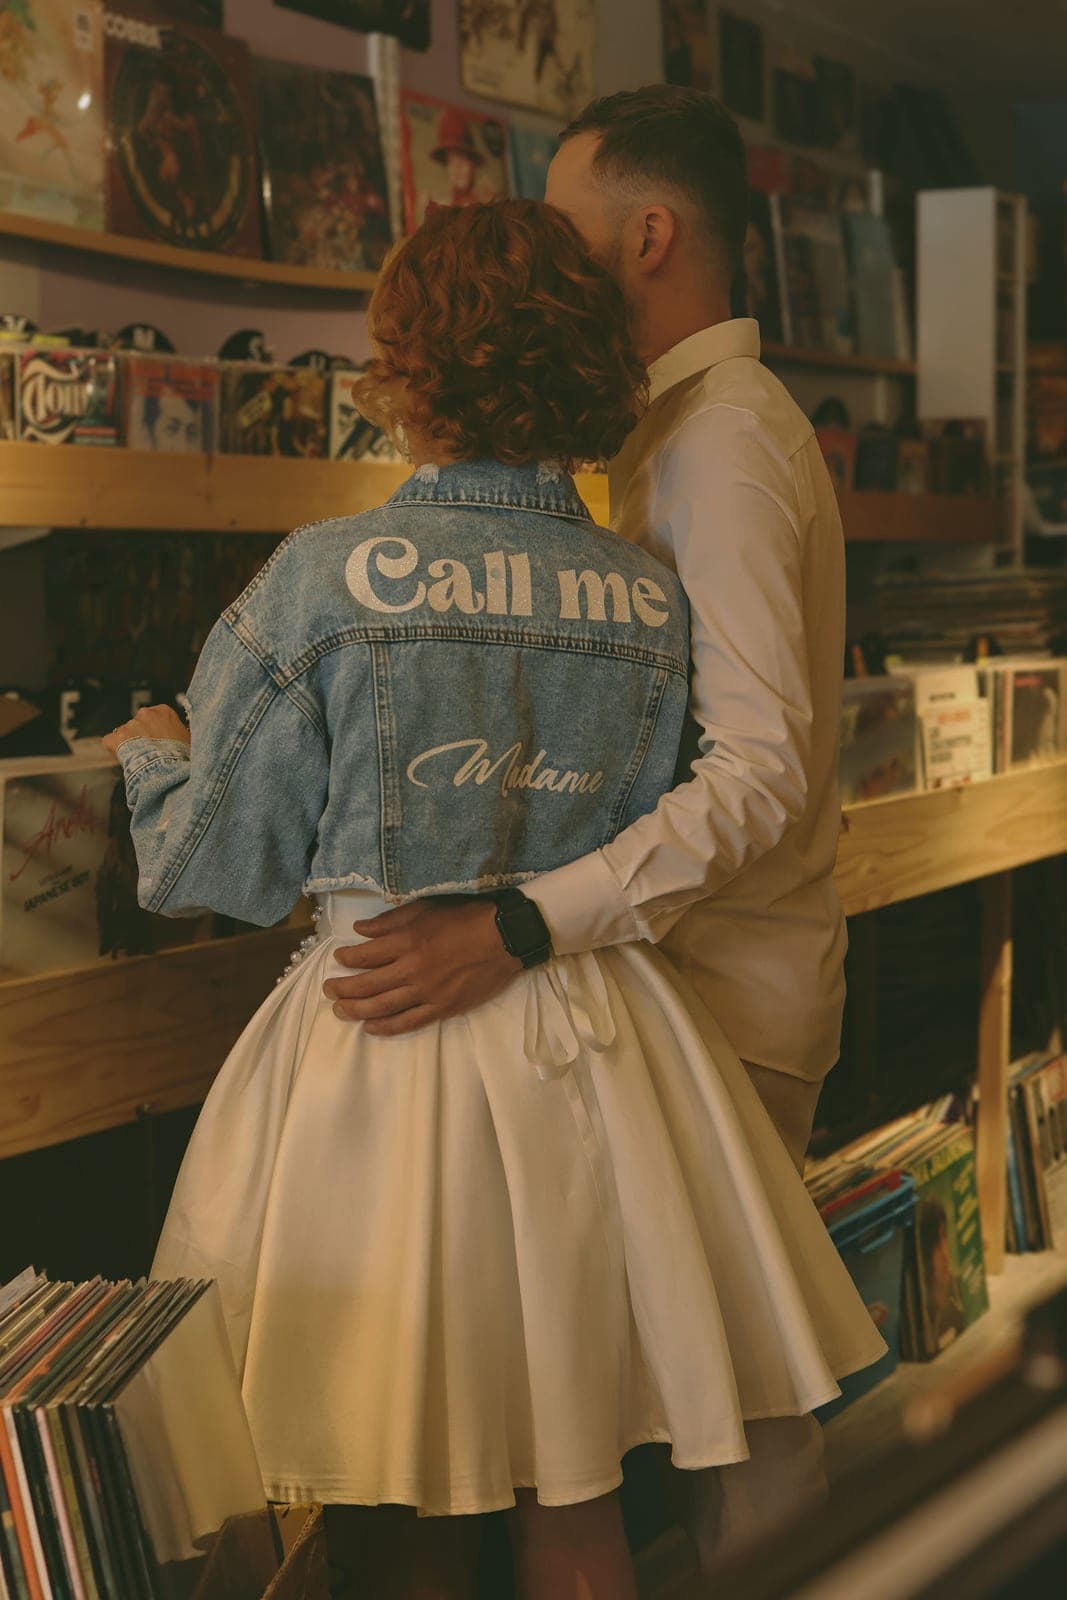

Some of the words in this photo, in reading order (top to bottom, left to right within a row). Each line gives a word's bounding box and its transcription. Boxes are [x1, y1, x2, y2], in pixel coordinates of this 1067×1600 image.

[345, 537, 533, 616] Call
[557, 569, 669, 627] me
[406, 738, 603, 798] Madame
